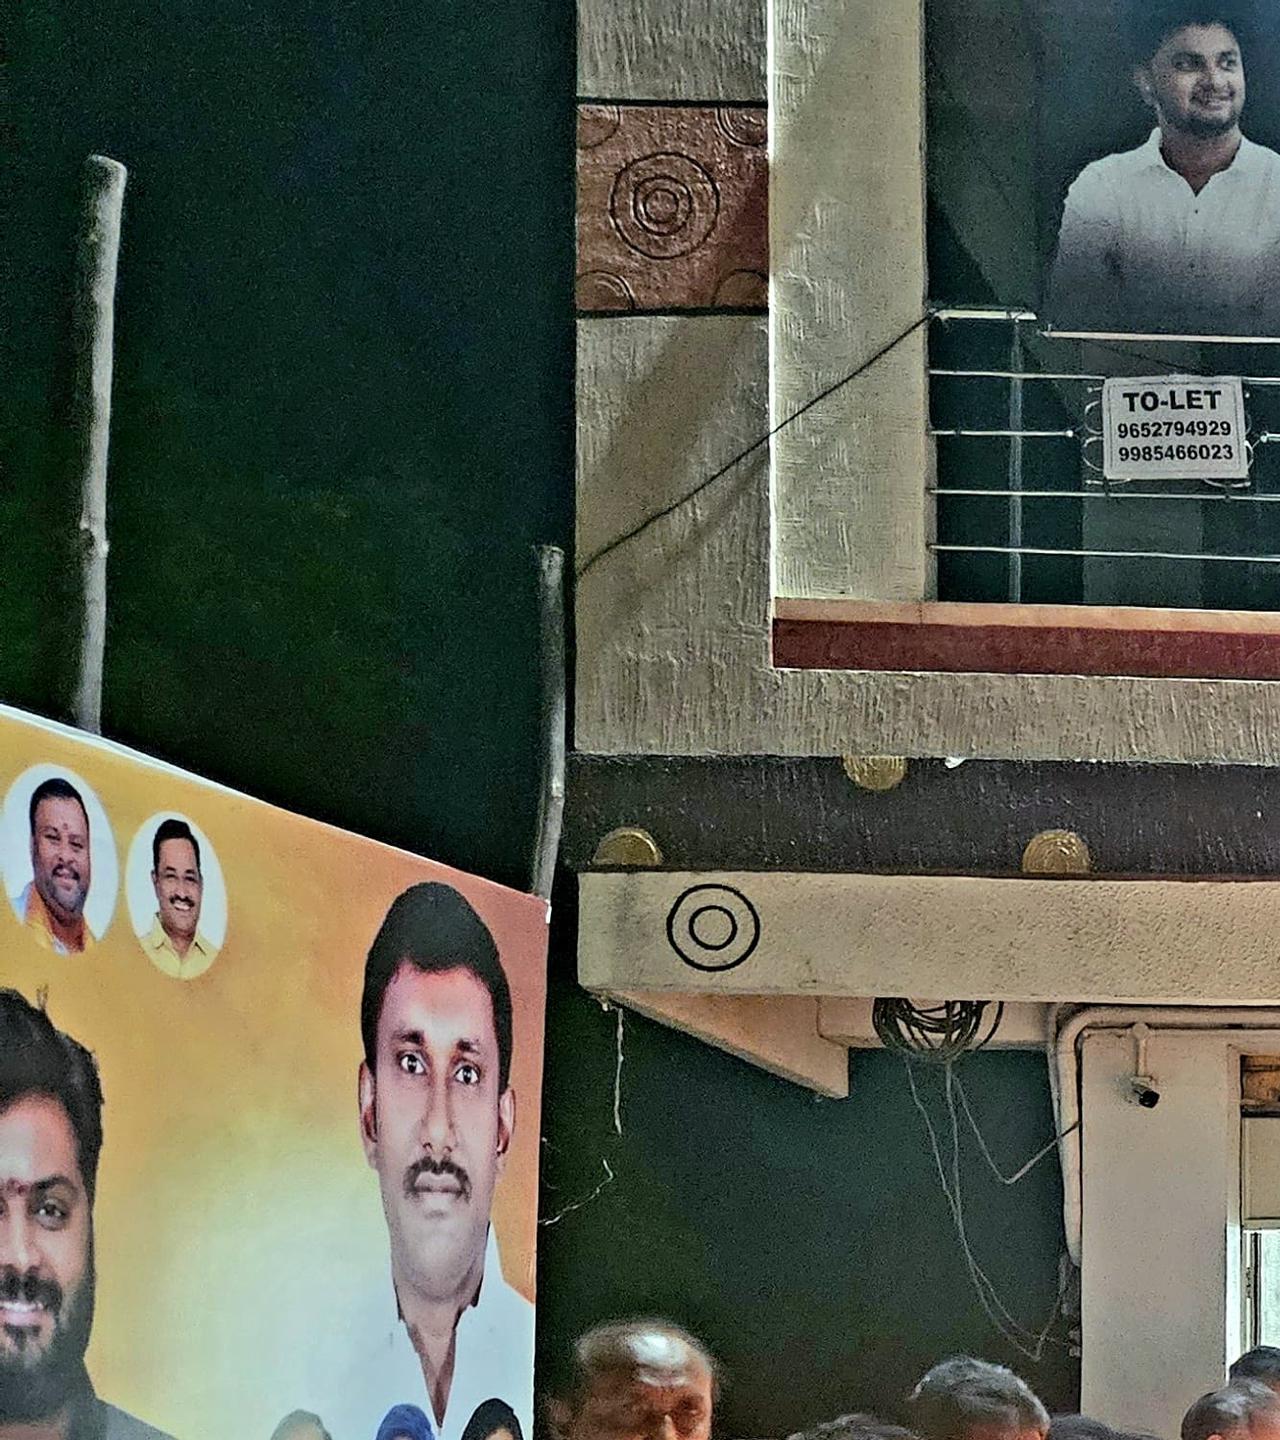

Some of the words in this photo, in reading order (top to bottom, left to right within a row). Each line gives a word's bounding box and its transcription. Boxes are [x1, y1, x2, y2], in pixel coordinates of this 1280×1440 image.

[1122, 389, 1222, 412] TO-LET
[1117, 420, 1232, 439] 9652794929
[1118, 444, 1234, 462] 9985466023
